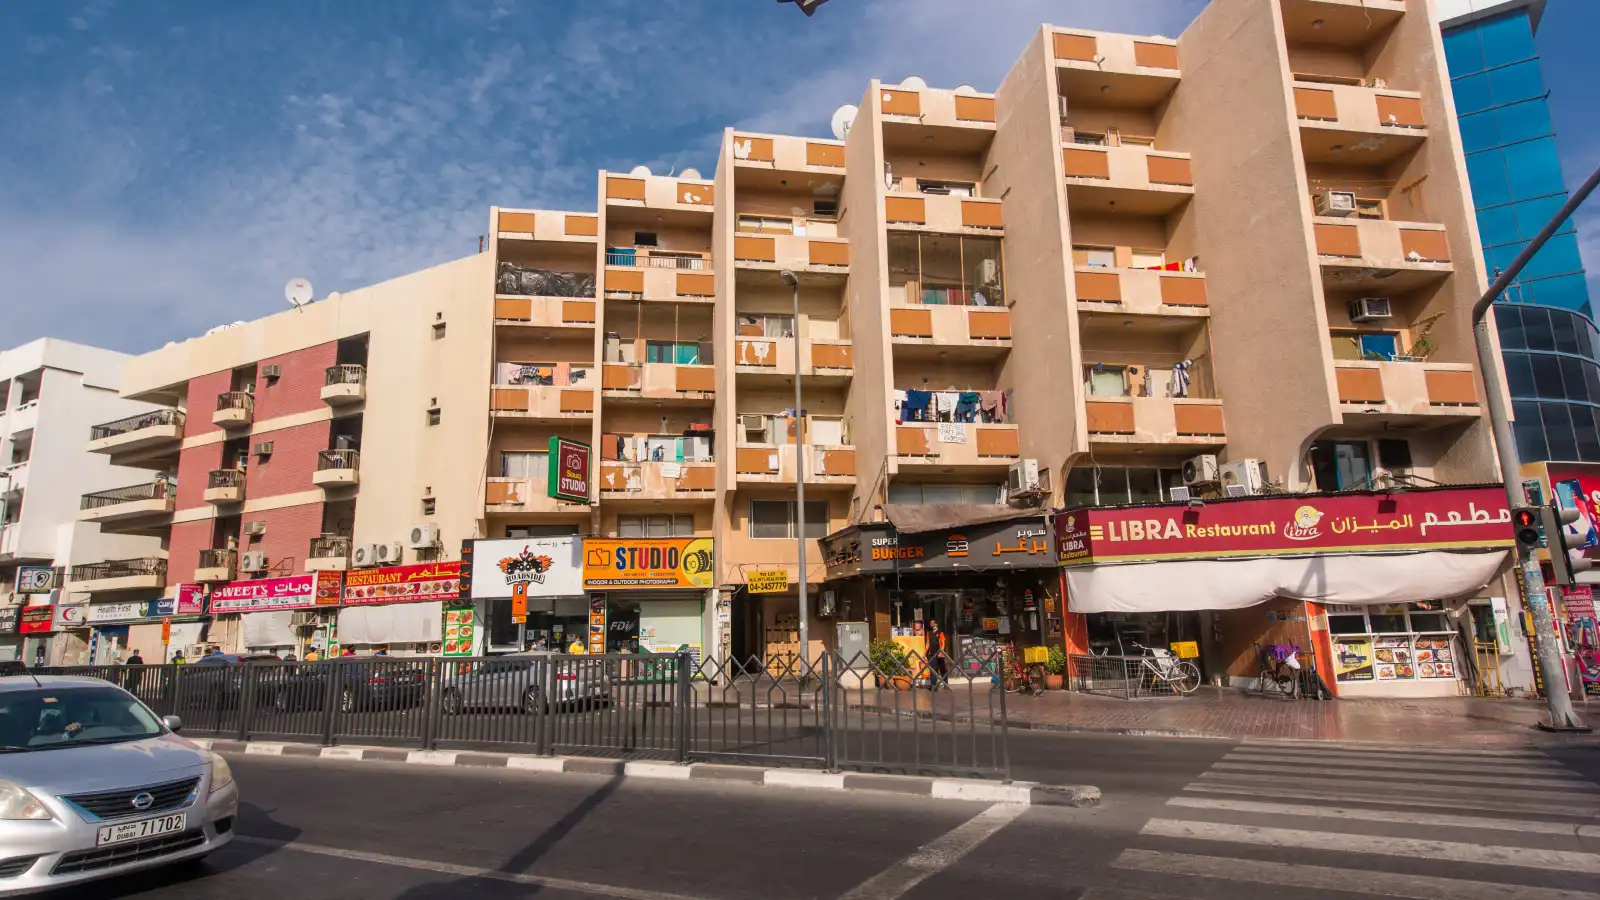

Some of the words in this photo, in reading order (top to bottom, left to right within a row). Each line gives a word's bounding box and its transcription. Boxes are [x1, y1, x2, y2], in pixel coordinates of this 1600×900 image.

[561, 478, 586, 492] STUDIO
[1331, 514, 1414, 534] الميزان
[1420, 502, 1512, 536] مطعم
[1017, 528, 1047, 538] سوبر
[1108, 518, 1183, 543] LIBRA
[1186, 521, 1276, 539] Restaurant
[1283, 521, 1321, 538] Libra
[872, 538, 898, 546] SUPER
[992, 536, 1048, 556] برغر
[1062, 540, 1084, 551] LIBRA
[615, 546, 679, 570] STUDIO
[871, 546, 924, 560] BURGER
[460, 547, 472, 591] CAFE
[347, 572, 402, 586] RESTAURANT
[505, 571, 545, 584] ROADSIDE
[274, 582, 313, 593] ويات
[749, 581, 787, 591] 04-3457779
[97, 605, 117, 613] Health
[117, 604, 132, 612] First
[103, 828, 112, 842] J
[140, 816, 182, 836] 71702
[117, 832, 136, 840] DUBAI
